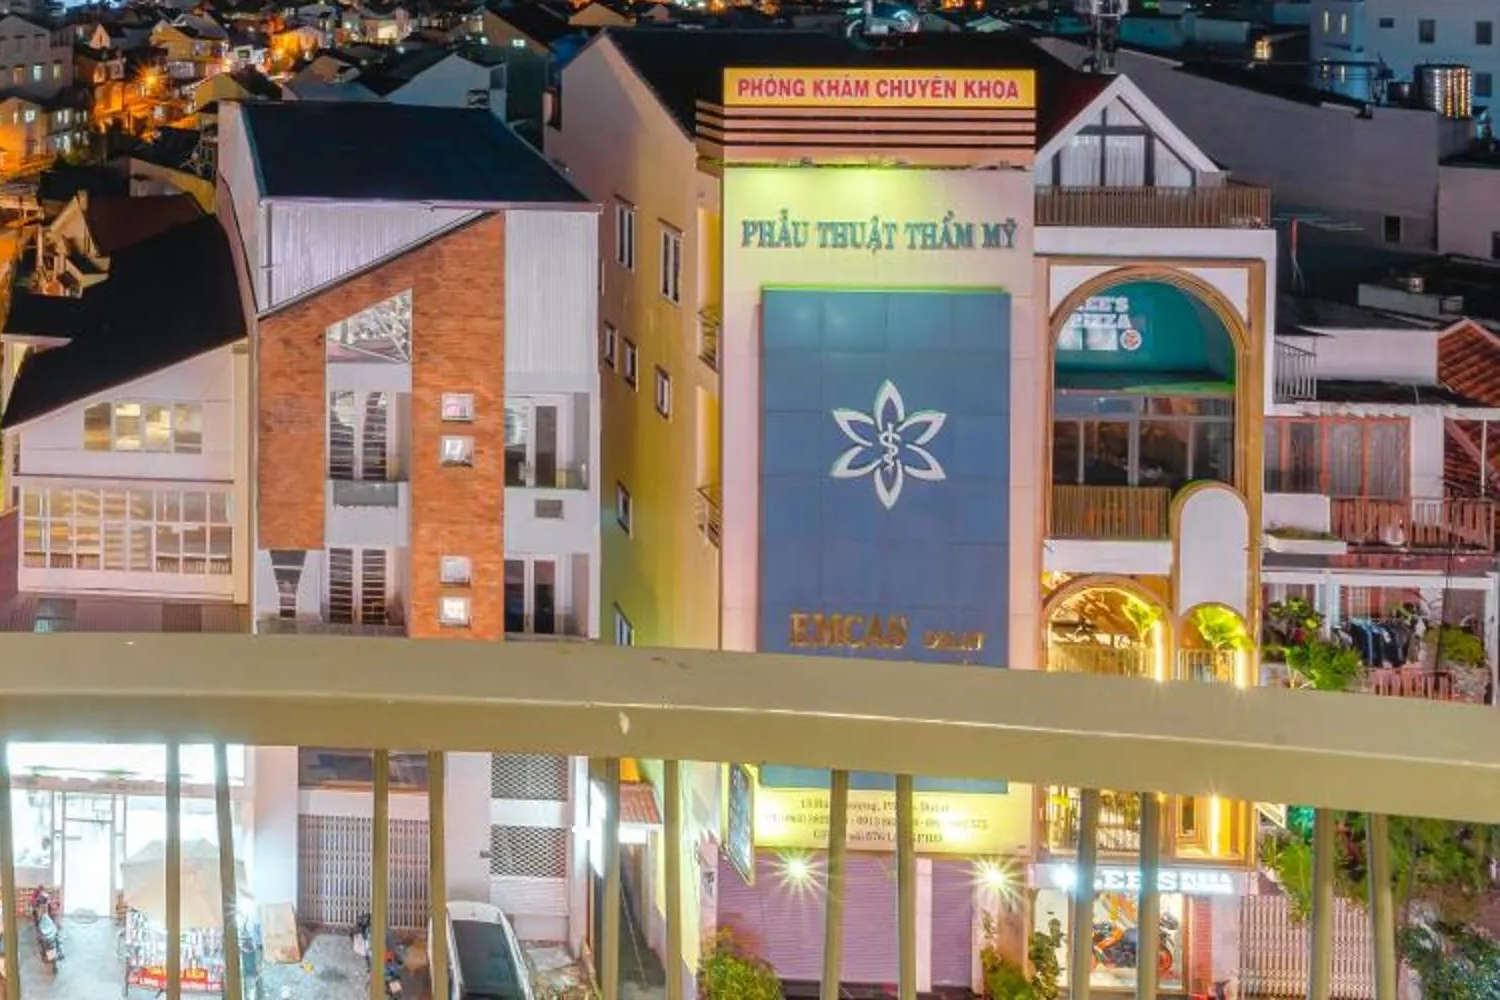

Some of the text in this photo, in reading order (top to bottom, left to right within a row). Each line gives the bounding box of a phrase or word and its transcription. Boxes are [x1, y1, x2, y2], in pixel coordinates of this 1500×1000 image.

[737, 74, 1019, 99] PHÒNG KHÁM CHUYÊN KHOA
